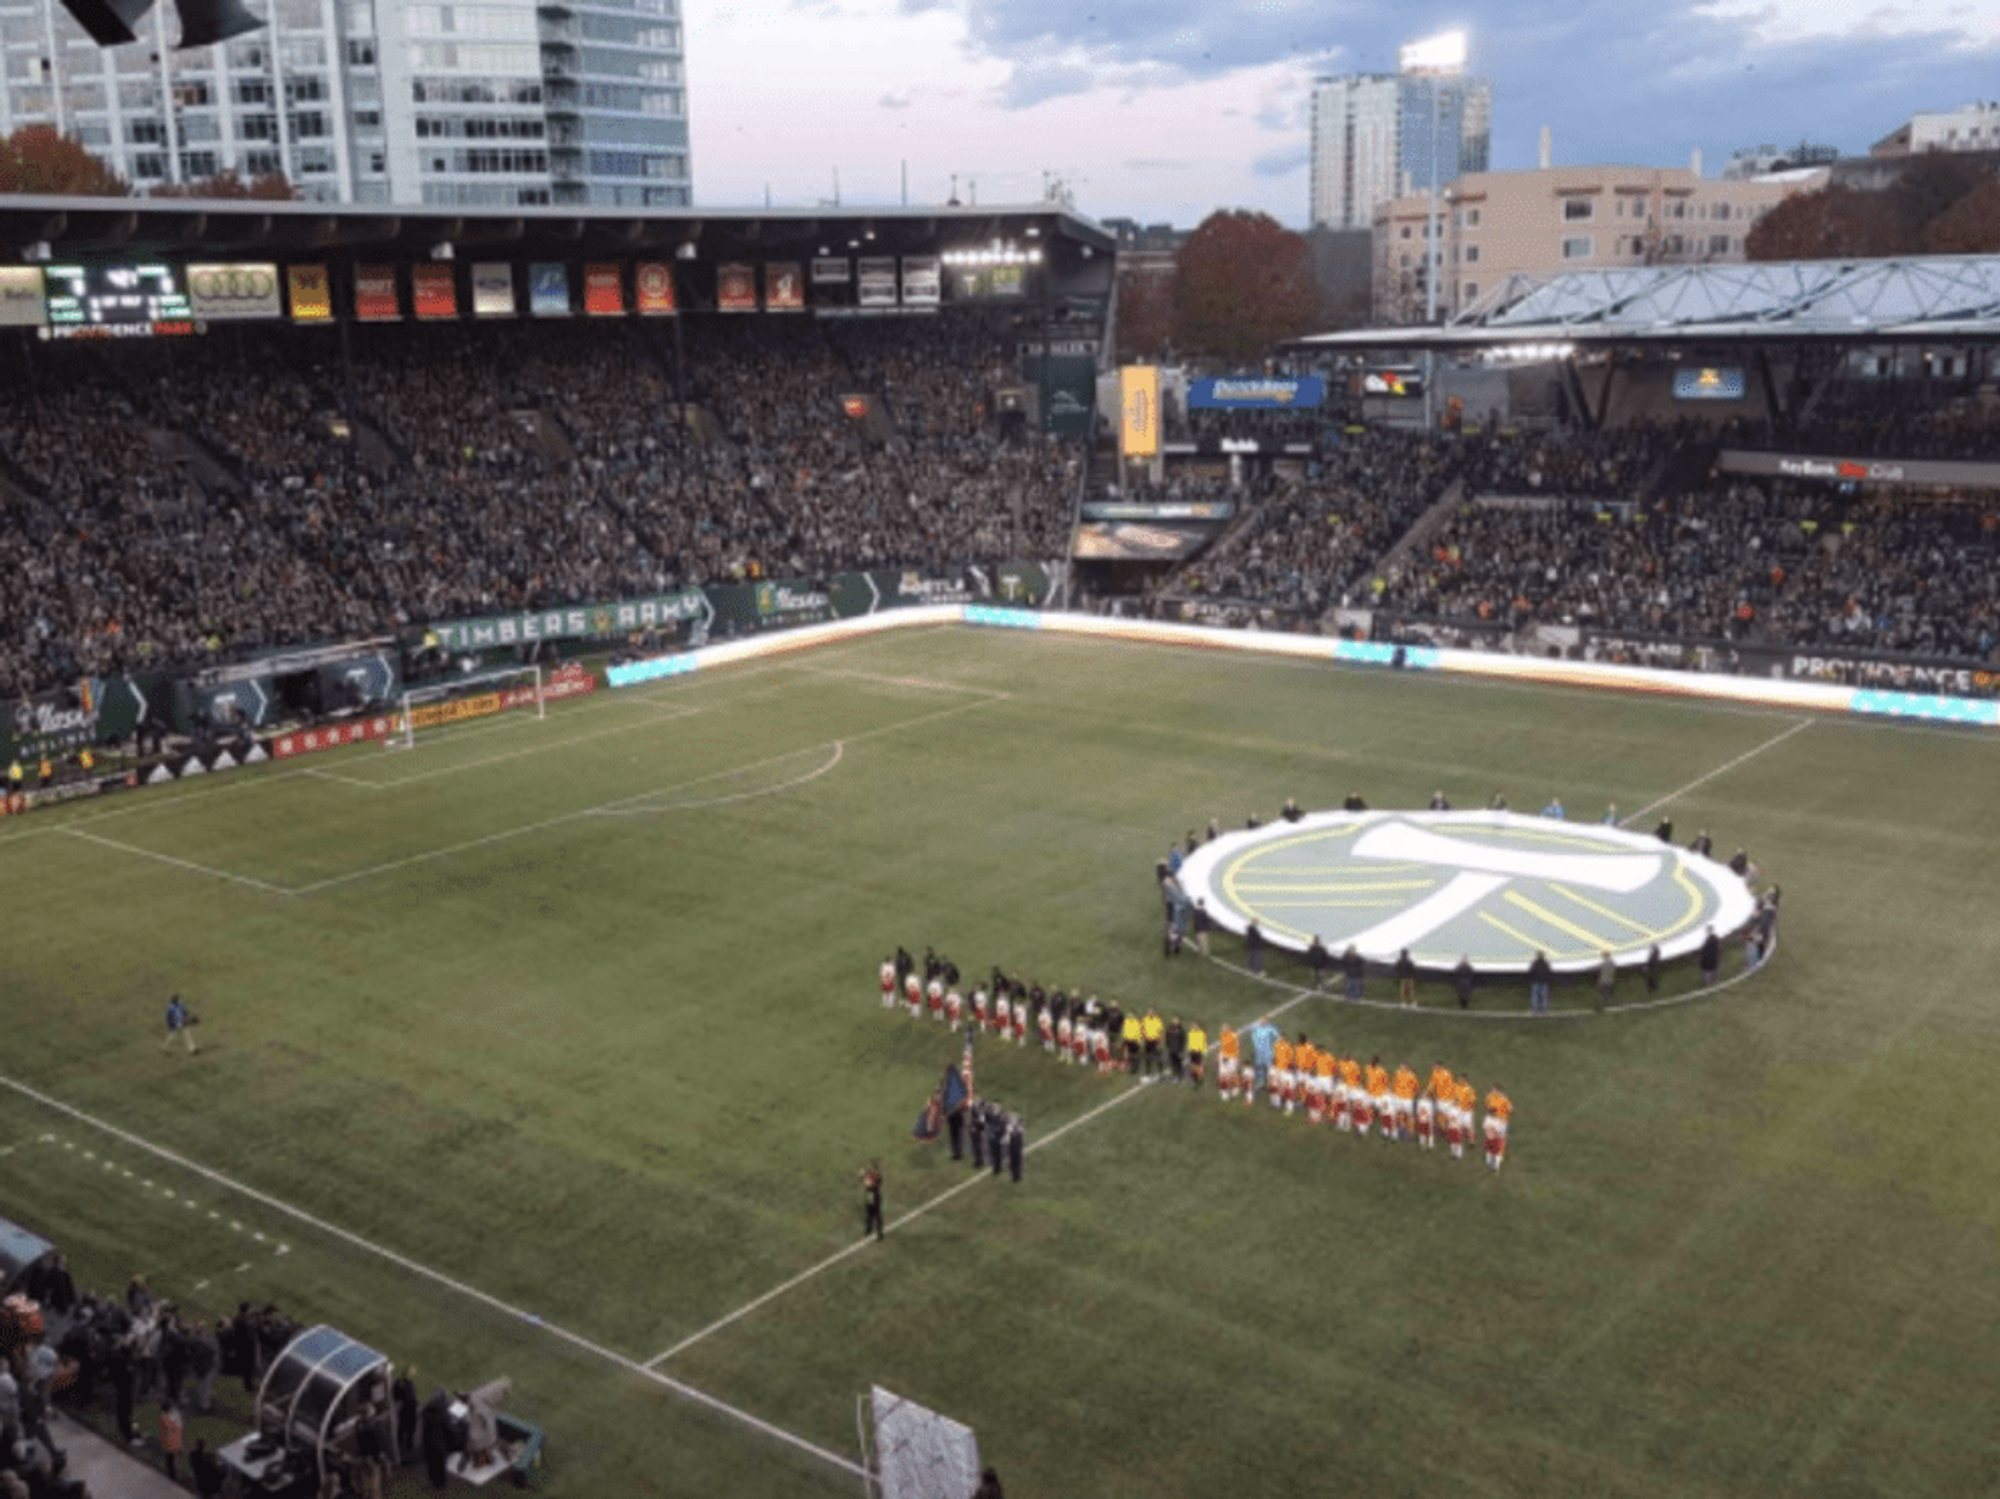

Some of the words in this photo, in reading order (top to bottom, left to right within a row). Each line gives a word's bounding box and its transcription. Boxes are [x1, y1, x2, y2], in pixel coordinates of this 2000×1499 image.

[436, 610, 587, 647] TIMBERS
[617, 594, 700, 626] ARMY
[1793, 656, 1971, 691] PROVIDENCE
